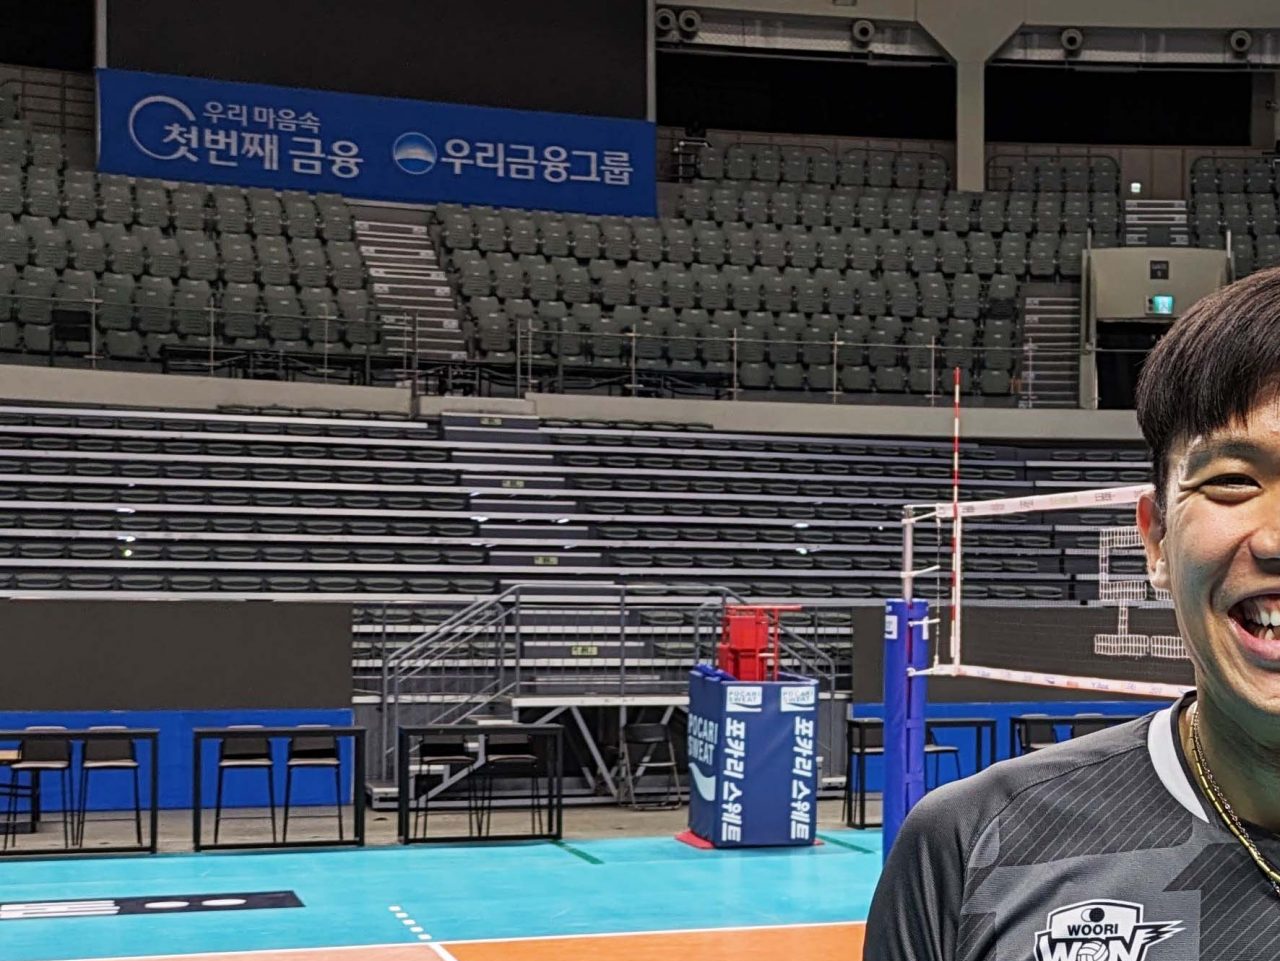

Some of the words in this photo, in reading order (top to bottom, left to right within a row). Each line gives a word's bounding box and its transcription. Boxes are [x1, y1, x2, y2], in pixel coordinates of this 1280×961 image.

[203, 101, 248, 127] 우리
[254, 106, 321, 134] 마음속
[162, 123, 279, 171] 첫번째
[289, 137, 364, 179] 금융
[440, 138, 634, 185] 우리금융그룹
[688, 713, 719, 745] POCARI
[688, 735, 715, 766] SWEAT
[724, 717, 746, 780] 포카리
[792, 715, 814, 778] 포카리
[721, 780, 743, 842] 스웨트
[790, 779, 811, 840] 스웨트
[1067, 923, 1118, 936] WOORI
